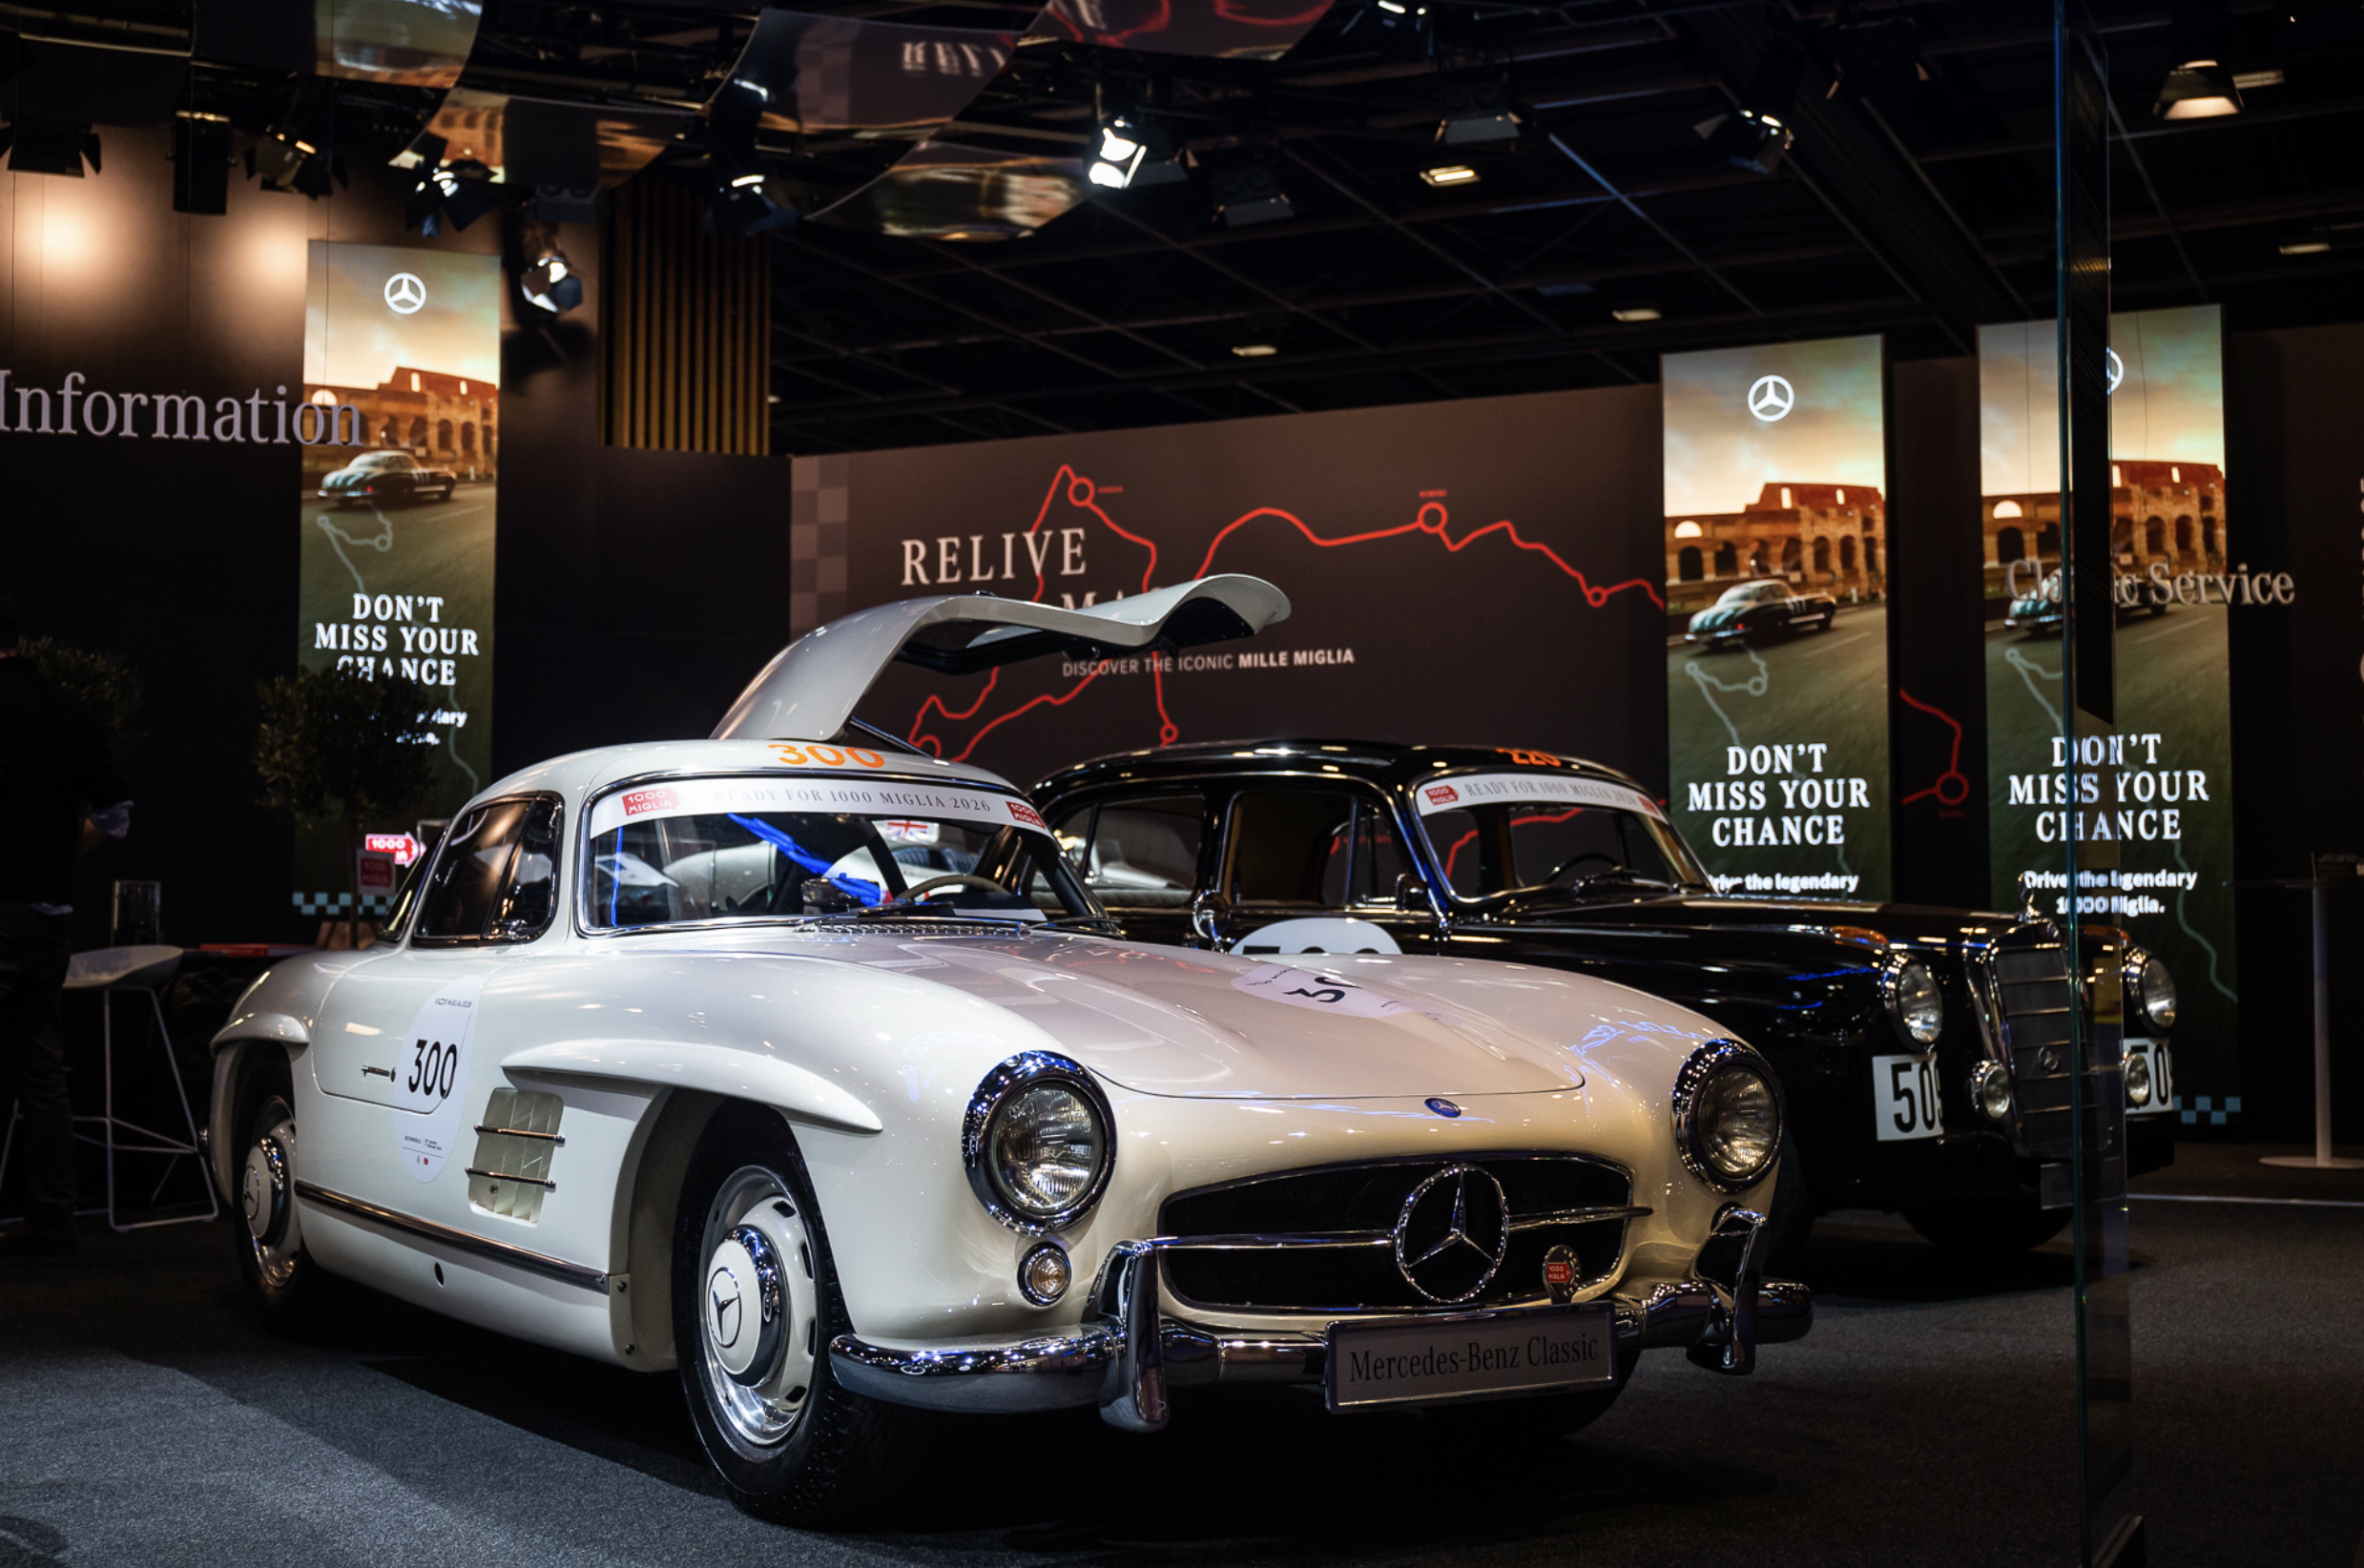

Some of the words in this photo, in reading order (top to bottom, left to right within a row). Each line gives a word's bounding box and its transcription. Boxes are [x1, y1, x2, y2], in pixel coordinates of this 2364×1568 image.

[0, 370, 363, 446] Information
[901, 527, 1087, 586] RELIVE
[2148, 562, 2295, 606] Service
[352, 593, 444, 623] DON'T
[314, 623, 387, 651] MISS
[400, 627, 479, 655] YOUR
[1063, 659, 1139, 677] DISCOVER
[1144, 658, 1172, 672] THE
[1178, 654, 1233, 671] ICONIC
[1239, 651, 1288, 669] MILLE
[1294, 649, 1355, 666] MIGLIA
[767, 744, 885, 768] 300
[1727, 743, 1827, 775] DON'T
[2051, 733, 2161, 767] DON'T
[628, 791, 667, 803] 1000
[715, 790, 777, 802] READY
[785, 790, 824, 801] FOR
[830, 790, 873, 803] 1000
[880, 792, 945, 808] MIGLIA
[950, 797, 990, 812] 2026
[1464, 781, 1508, 796] READY
[1510, 781, 1538, 794] FOR
[1539, 782, 1567, 794] 1000
[1568, 784, 1610, 800] MIGLIA
[1688, 780, 1766, 811] MISS
[1779, 778, 1870, 809] YOUR
[2116, 770, 2209, 802] YOUR
[628, 800, 673, 815] MIGLIA
[1010, 803, 1037, 817] 1000
[1014, 814, 1042, 827] MIGLIA
[1712, 815, 1844, 847] CHANCE
[2036, 809, 2181, 842] CHANCE
[372, 838, 405, 850] 1000
[1745, 873, 1773, 891] the
[1775, 872, 1858, 893] legendary
[408, 1039, 458, 1100] 300
[1350, 1342, 1520, 1382] Mercedes-Benz
[1527, 1332, 1598, 1367] Classic
